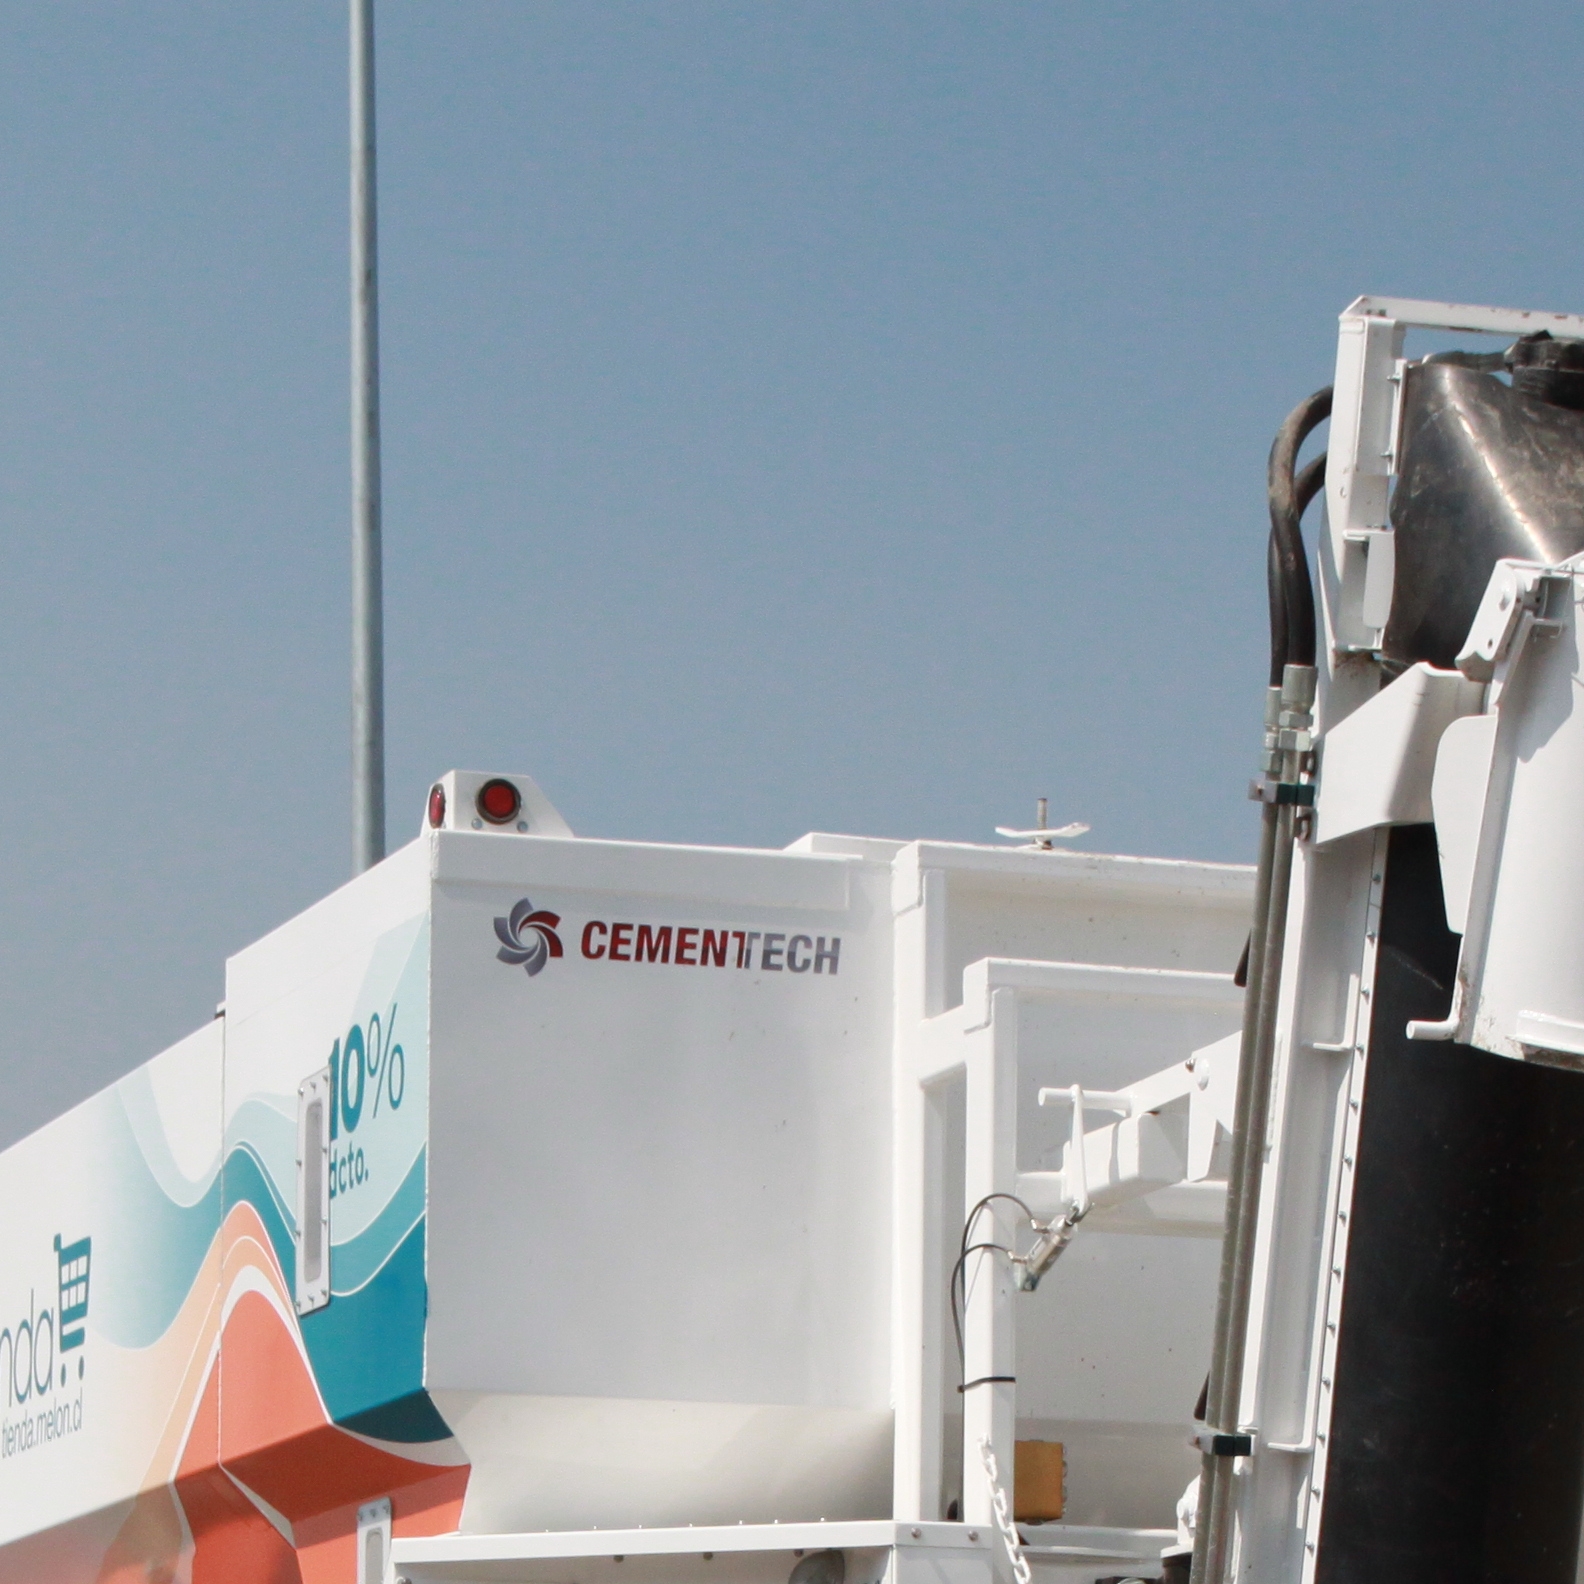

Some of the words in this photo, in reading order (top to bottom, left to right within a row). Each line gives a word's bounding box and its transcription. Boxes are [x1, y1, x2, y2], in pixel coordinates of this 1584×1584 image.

[581, 919, 842, 976] CEMENTECH
[327, 1001, 406, 1143] 10%
[1, 1386, 84, 1460] tienda.melon.cl
